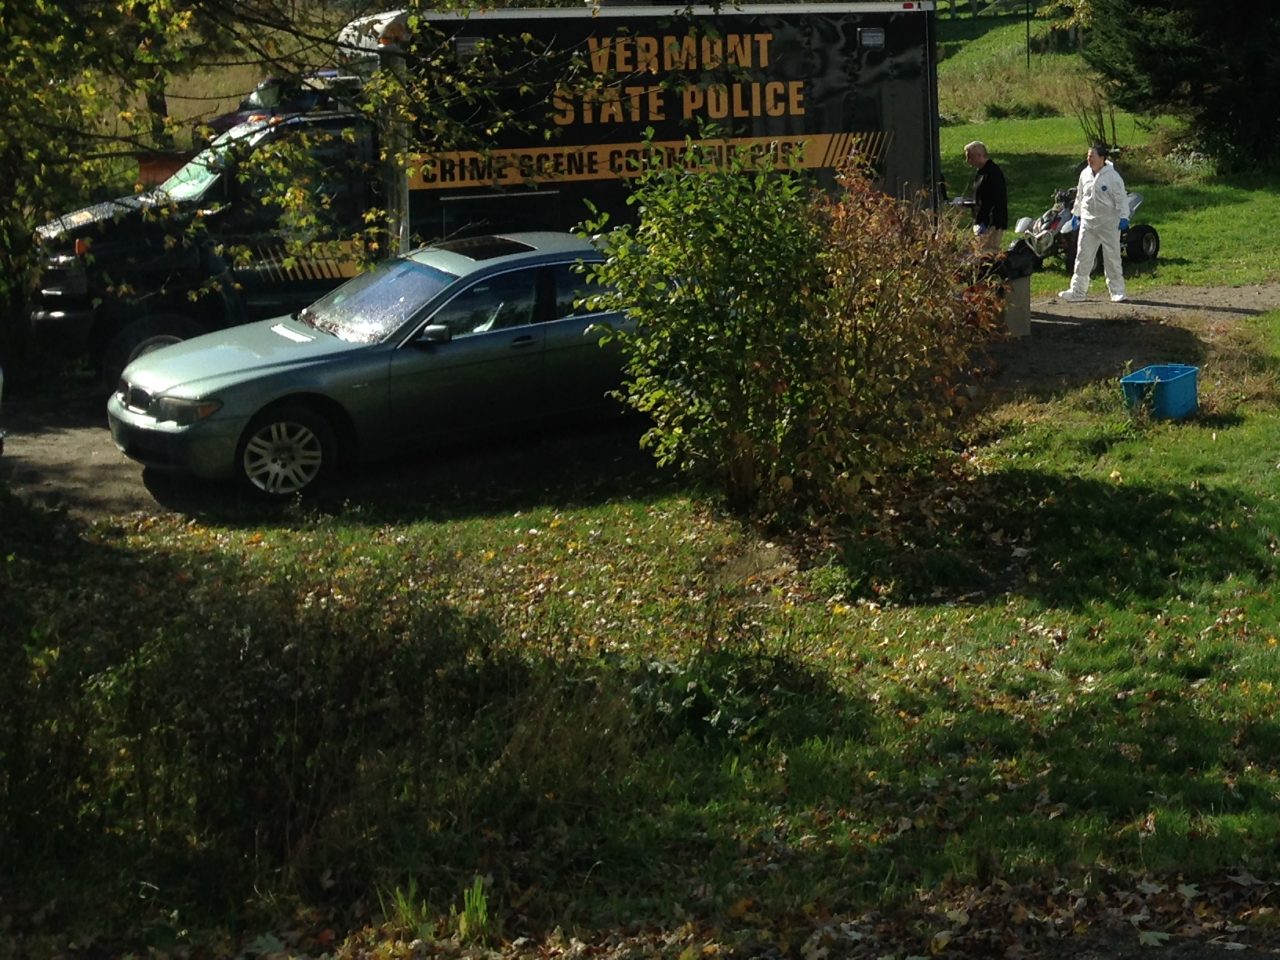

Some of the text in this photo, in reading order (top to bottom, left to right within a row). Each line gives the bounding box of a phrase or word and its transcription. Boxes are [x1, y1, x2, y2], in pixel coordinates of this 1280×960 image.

[587, 33, 773, 75] VERMONT
[552, 81, 806, 126] STATE POLICE
[422, 151, 508, 183] CRIME
[519, 146, 599, 178] SCENE
